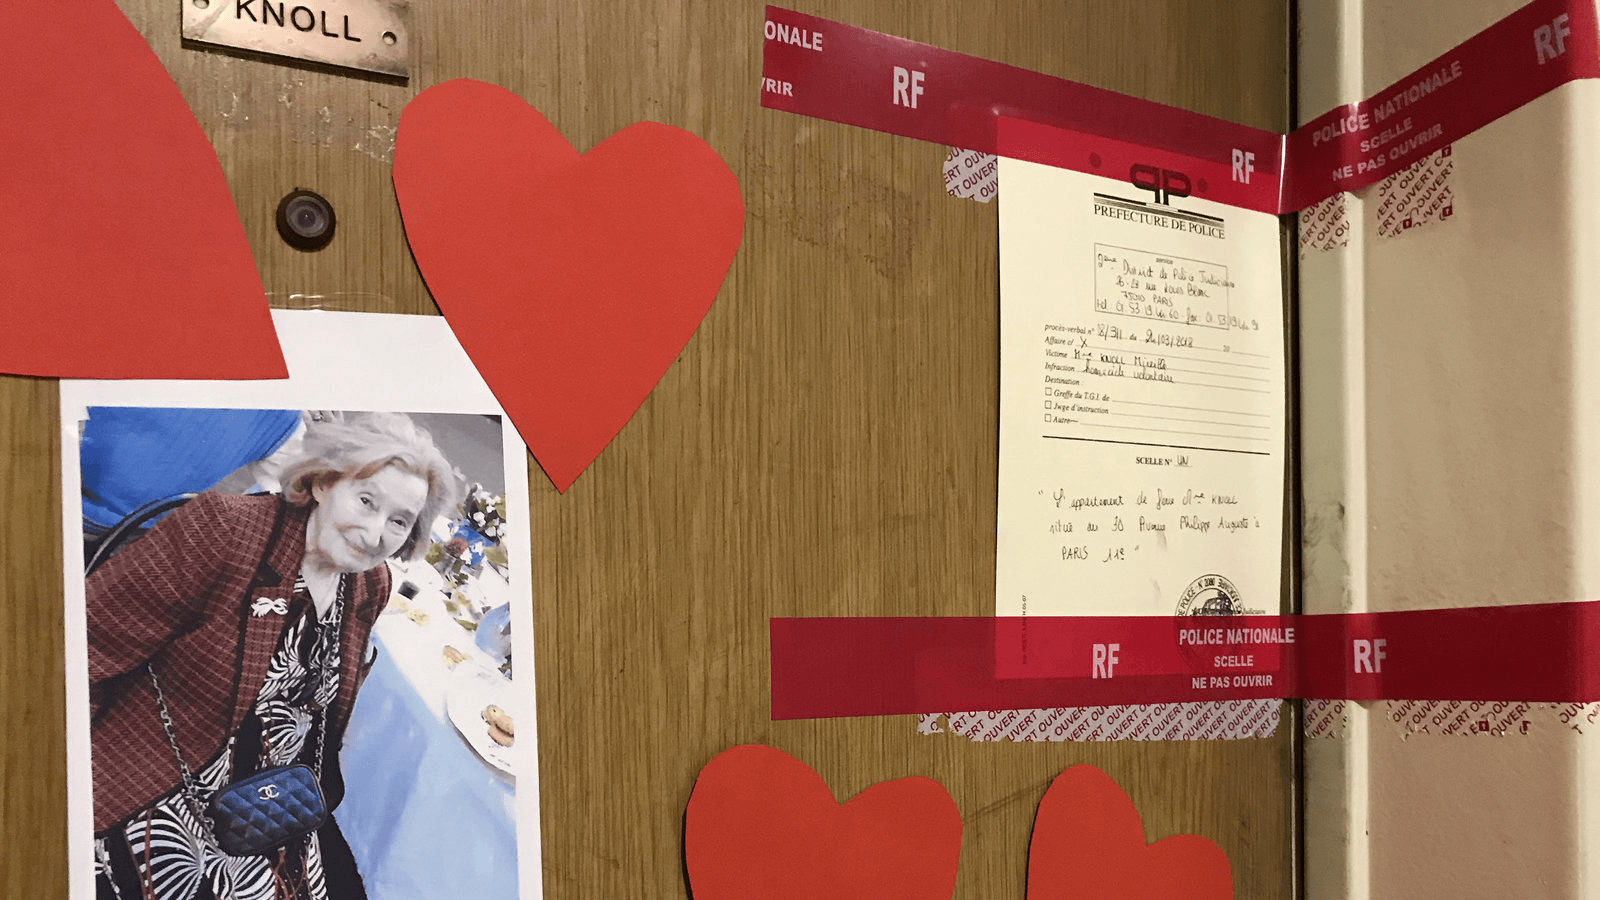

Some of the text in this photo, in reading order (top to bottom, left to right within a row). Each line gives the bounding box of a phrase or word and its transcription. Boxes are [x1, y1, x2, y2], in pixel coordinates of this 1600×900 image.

[236, 0, 361, 43] KNOLL
[1533, 13, 1571, 65] RF
[893, 65, 925, 109] RF
[1312, 60, 1463, 147] POLICE NATIONALE
[1360, 117, 1413, 153] SCELLE
[1232, 148, 1255, 184] RF
[1333, 123, 1443, 182] NE PAS OUVRIR
[1397, 166, 1433, 213] OUVERT
[1094, 204, 1225, 239] PREFECTURE DE POLICE
[1045, 336, 1066, 345] Affaire
[1046, 349, 1068, 358] Victime
[1045, 362, 1075, 371] Infraction
[1045, 375, 1080, 386] Destination
[1054, 389, 1073, 400] Greffe
[1136, 456, 1163, 466] SCELLE
[1062, 545, 1089, 560] PARIS
[1180, 628, 1295, 645] POLICE NATIONALE
[1093, 643, 1120, 679] RF
[1214, 655, 1254, 667] SCELLE
[1353, 638, 1387, 673] RF
[1192, 675, 1273, 689] NE PAS OUVRIR
[1152, 703, 1184, 736] OUVERT
[1241, 701, 1270, 735] OUVERT
